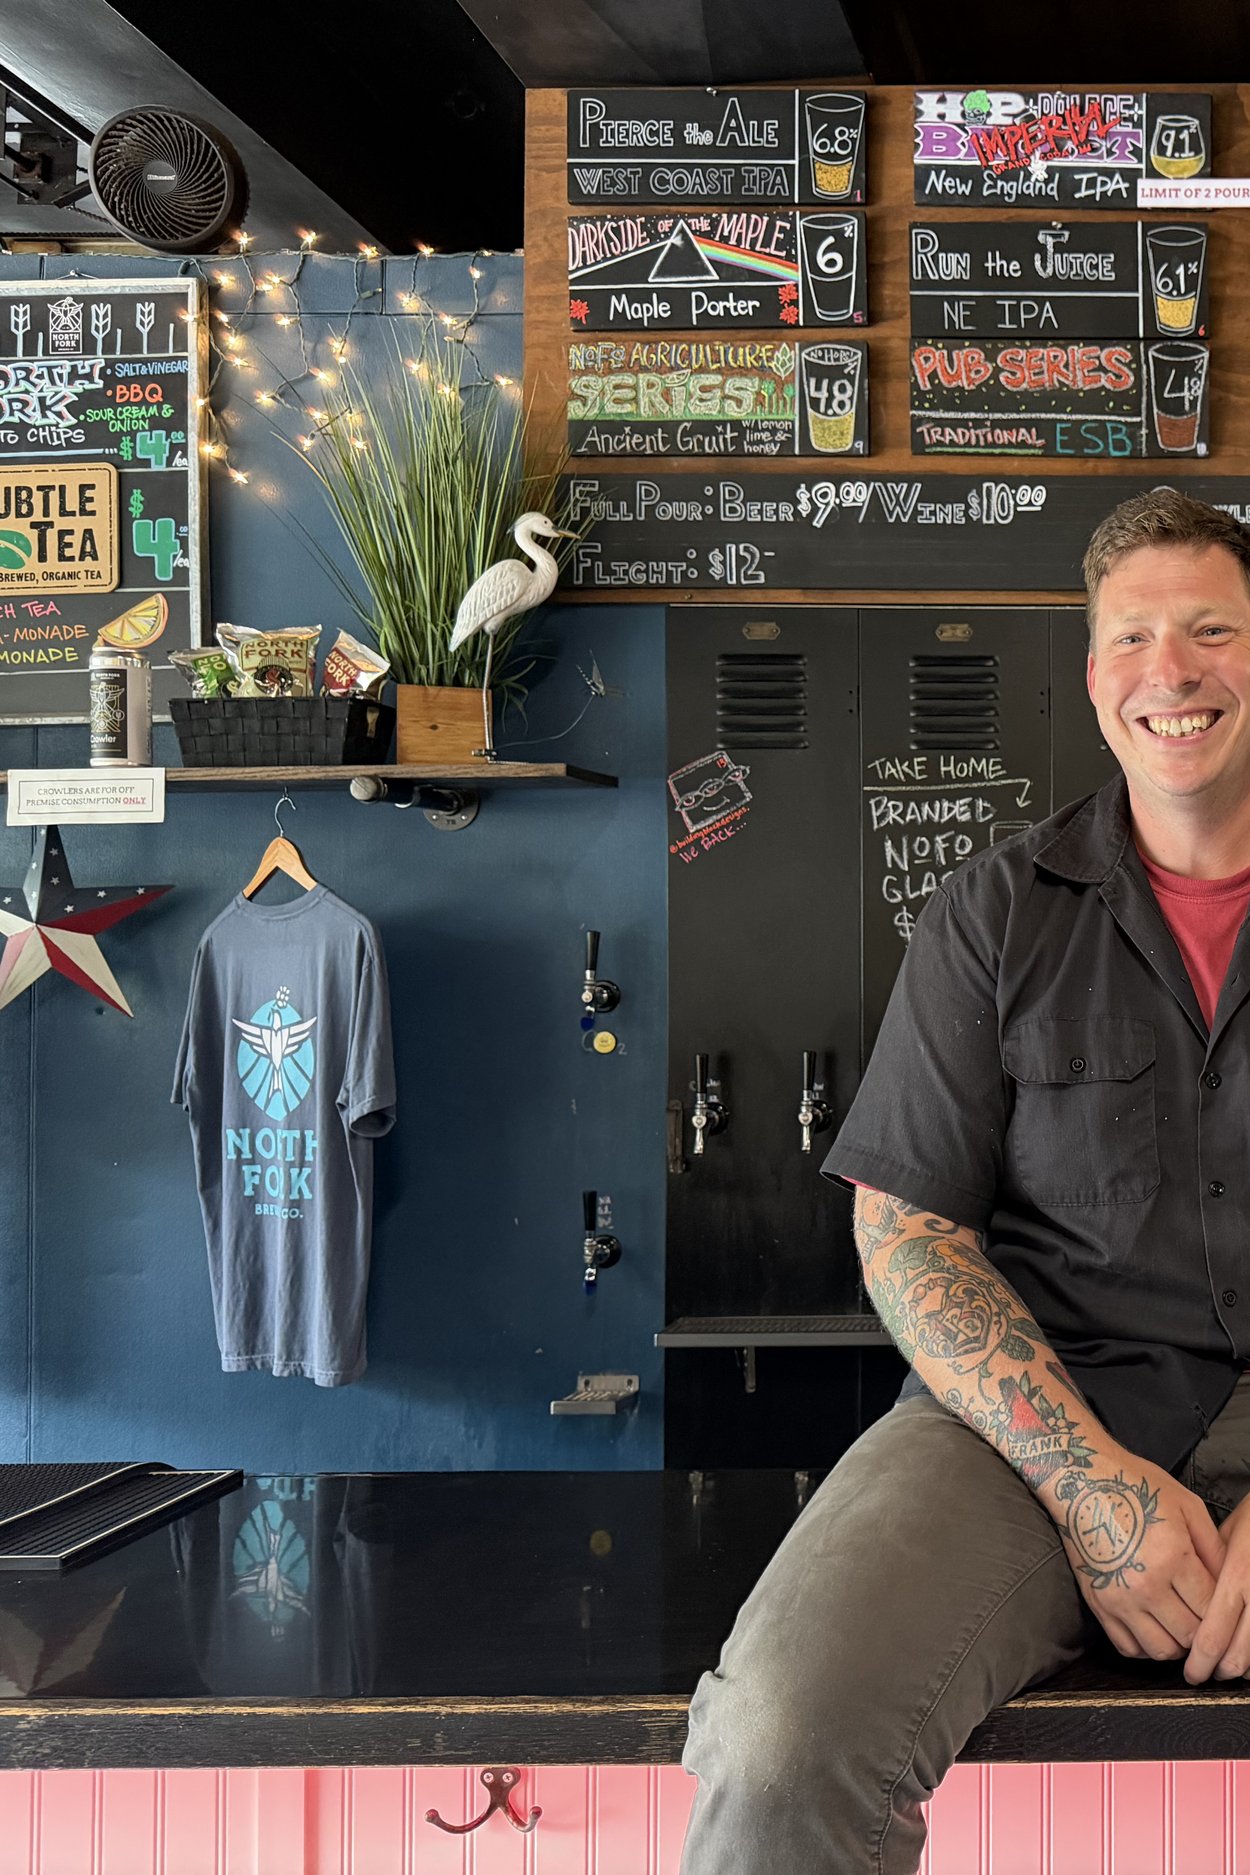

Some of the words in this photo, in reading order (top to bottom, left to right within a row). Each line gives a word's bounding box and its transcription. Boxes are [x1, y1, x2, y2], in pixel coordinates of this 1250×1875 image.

[580, 98, 674, 147] PIERCE
[683, 122, 713, 145] the
[716, 97, 779, 147] ALE
[574, 167, 642, 195] WEST
[649, 167, 735, 195] COAST
[741, 167, 790, 196] IPA
[925, 169, 972, 195] New
[982, 169, 1059, 202] England
[1074, 172, 1130, 201] IPA
[1141, 186, 1181, 198] LIMIT
[1183, 187, 1201, 198] OF
[1204, 187, 1212, 198] 2
[568, 216, 650, 271] DARKSIDE
[657, 220, 673, 233] OF
[687, 218, 711, 232] THE
[714, 212, 791, 257] MAPLE
[912, 228, 970, 280] RUN
[984, 251, 1021, 278] the
[1034, 229, 1115, 280] JUICE
[609, 293, 672, 326] Maple
[691, 291, 760, 325] Porter
[943, 301, 976, 330] NE
[996, 301, 1058, 329] IPA
[629, 344, 775, 370] AGRICULTURE
[913, 347, 991, 391] PUB
[997, 346, 1133, 391] SERIES
[116, 384, 163, 403] BBQ
[568, 371, 760, 417] SERIES
[86, 408, 114, 422] SOUR
[116, 406, 158, 419] CREAM
[161, 405, 174, 418] &
[109, 420, 149, 433] ONION
[27, 426, 85, 447] CHIPS
[577, 426, 671, 454] Ancient
[677, 424, 739, 453] Gruit
[743, 441, 781, 455] honey
[745, 430, 767, 442] lime
[916, 422, 1046, 447] TRADITIONAL
[1055, 422, 1132, 456] ESB
[720, 481, 794, 522] BEER
[30, 521, 99, 563] TEA
[42, 570, 81, 581] ORGANIC
[84, 569, 102, 579] TEA
[21, 601, 61, 618] TEA
[244, 649, 302, 658] FORK
[246, 640, 303, 648] NORTH
[329, 651, 357, 676] NORTH
[867, 757, 928, 781] TAKE
[941, 755, 1007, 779] HOME
[26, 799, 61, 807] PREMISE
[61, 797, 121, 806] CONSUMPTION
[38, 788, 83, 796] CROWLERS
[84, 787, 100, 795] ARE
[869, 796, 997, 831] BRANDED
[226, 1127, 318, 1161] NOTH
[242, 1165, 312, 1200] FOK
[1011, 1436, 1062, 1457] FRANK
